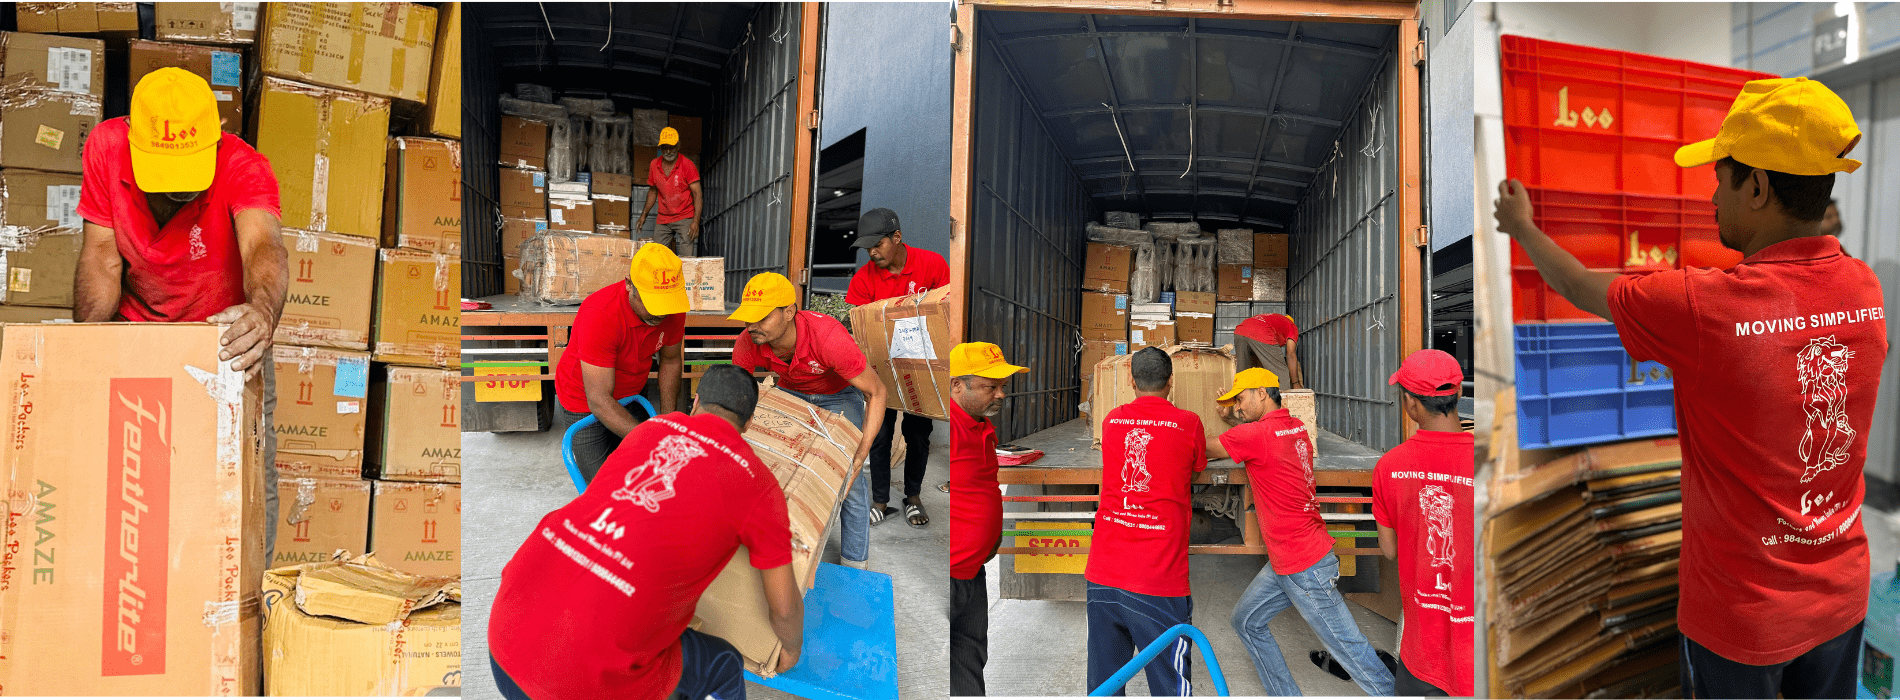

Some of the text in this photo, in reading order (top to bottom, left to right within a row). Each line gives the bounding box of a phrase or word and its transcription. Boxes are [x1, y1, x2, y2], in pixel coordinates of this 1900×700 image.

[1553, 86, 1615, 130] Leo
[162, 119, 197, 142] Leo
[1624, 230, 1678, 267] Leo
[745, 285, 763, 297] Leo
[1735, 307, 1884, 337] MOVING SIMPLIFIED
[486, 374, 531, 389] STOP
[276, 424, 328, 438] AMAZE
[1391, 471, 1475, 487] MOVING SIMPLIFIE
[1801, 489, 1834, 516] Leo
[33, 479, 58, 585] AMAZE
[117, 390, 167, 654] Featherlite
[1804, 522, 1816, 532] and
[1028, 538, 1080, 557] STOP
[1761, 535, 1778, 546] Call
[1784, 531, 1835, 546] 9849013531
[275, 552, 327, 563] AMAZE
[404, 551, 454, 562] AMAZE
[225, 536, 240, 602] Leo Packe
[222, 676, 236, 697] Le
